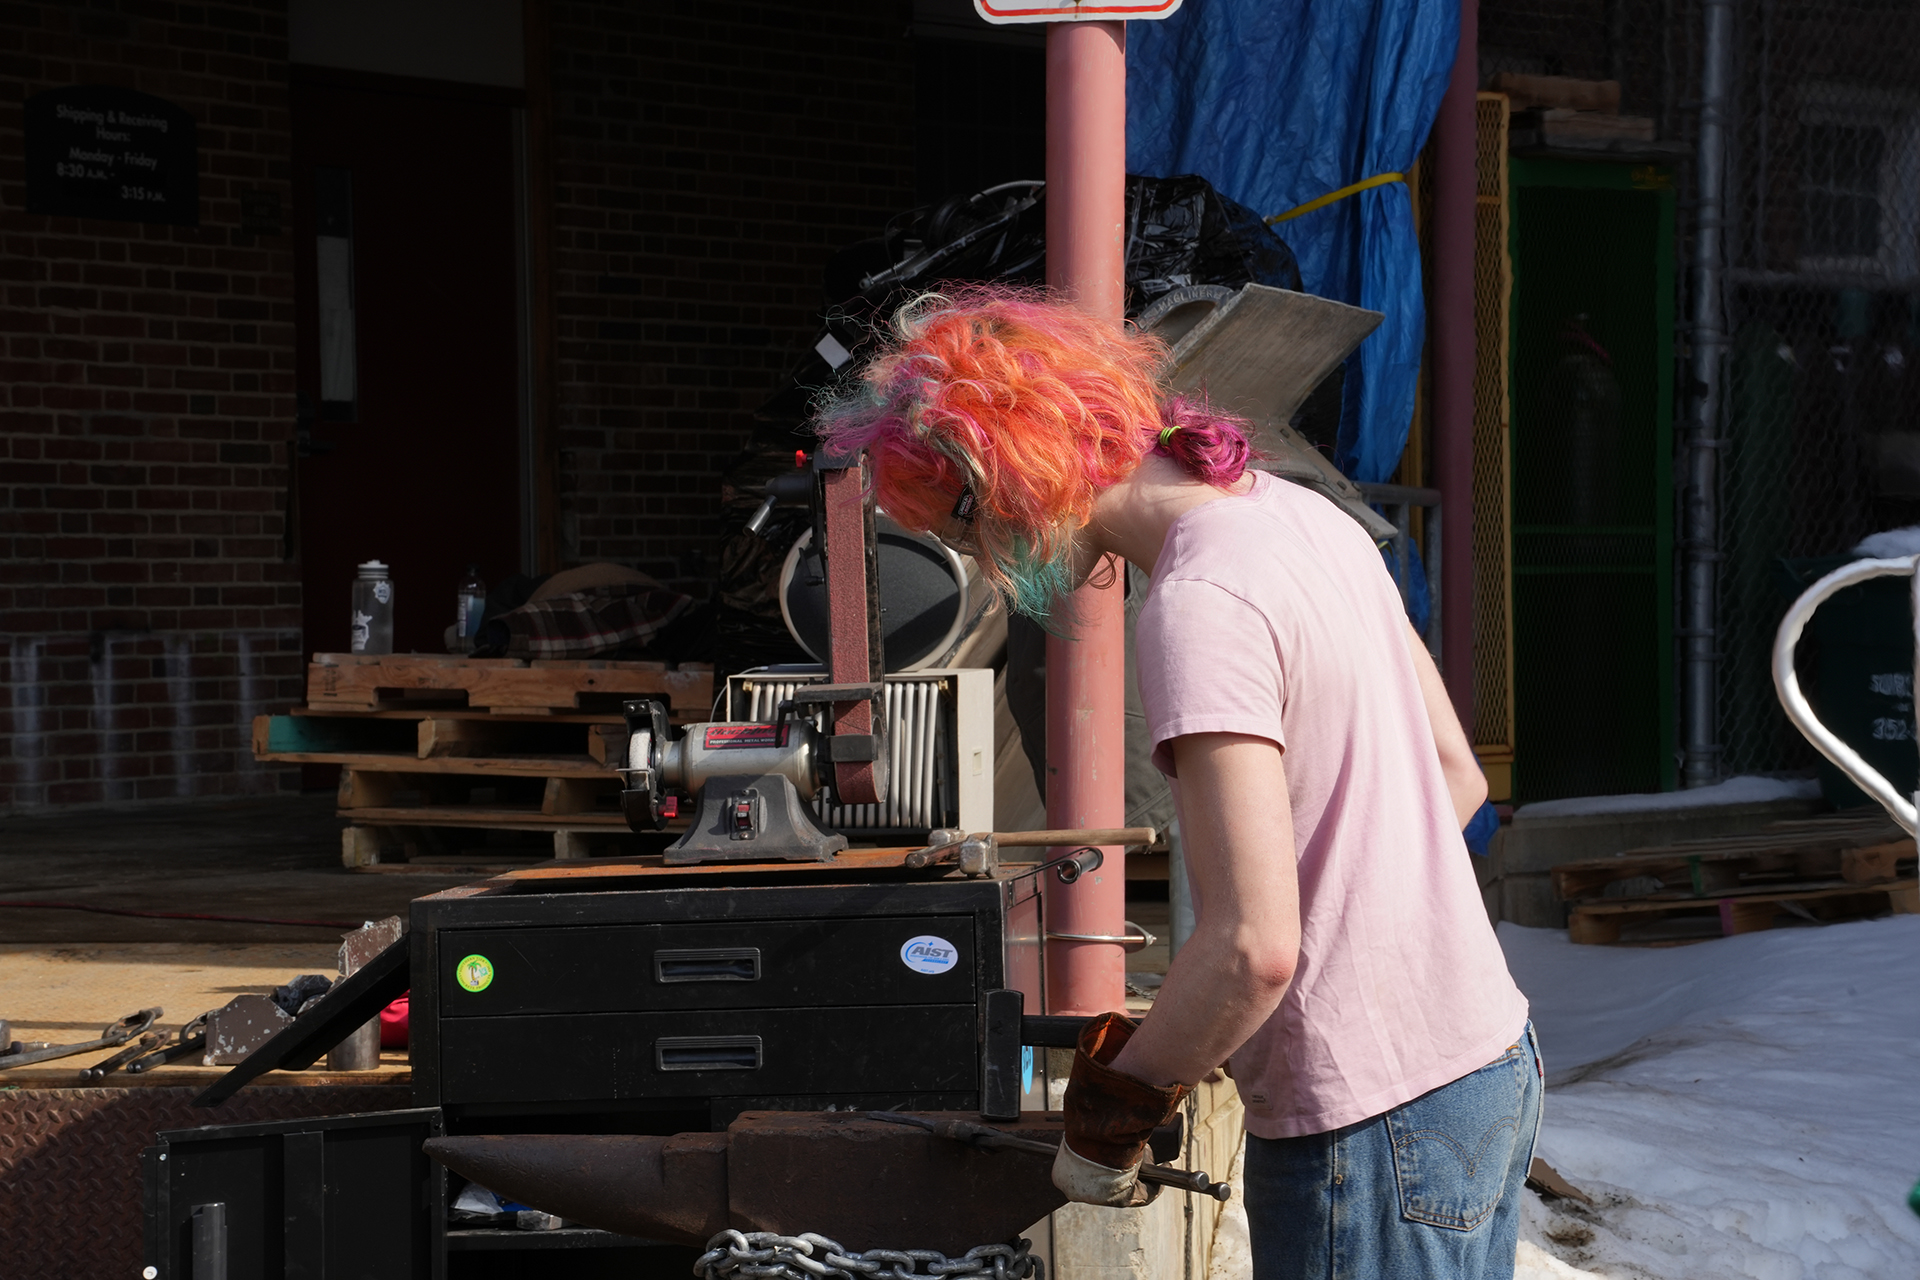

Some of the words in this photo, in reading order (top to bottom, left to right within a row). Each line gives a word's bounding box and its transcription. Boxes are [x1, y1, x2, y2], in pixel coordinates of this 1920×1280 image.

[56, 103, 105, 126] Shipping
[106, 110, 117, 124] &
[118, 110, 169, 134] Receiving
[95, 125, 132, 142] Hours:
[68, 146, 115, 168] Monday
[123, 151, 159, 172] Friday
[56, 161, 85, 178] 8:30
[121, 184, 145, 200] 3:15
[911, 946, 954, 958] AIST
